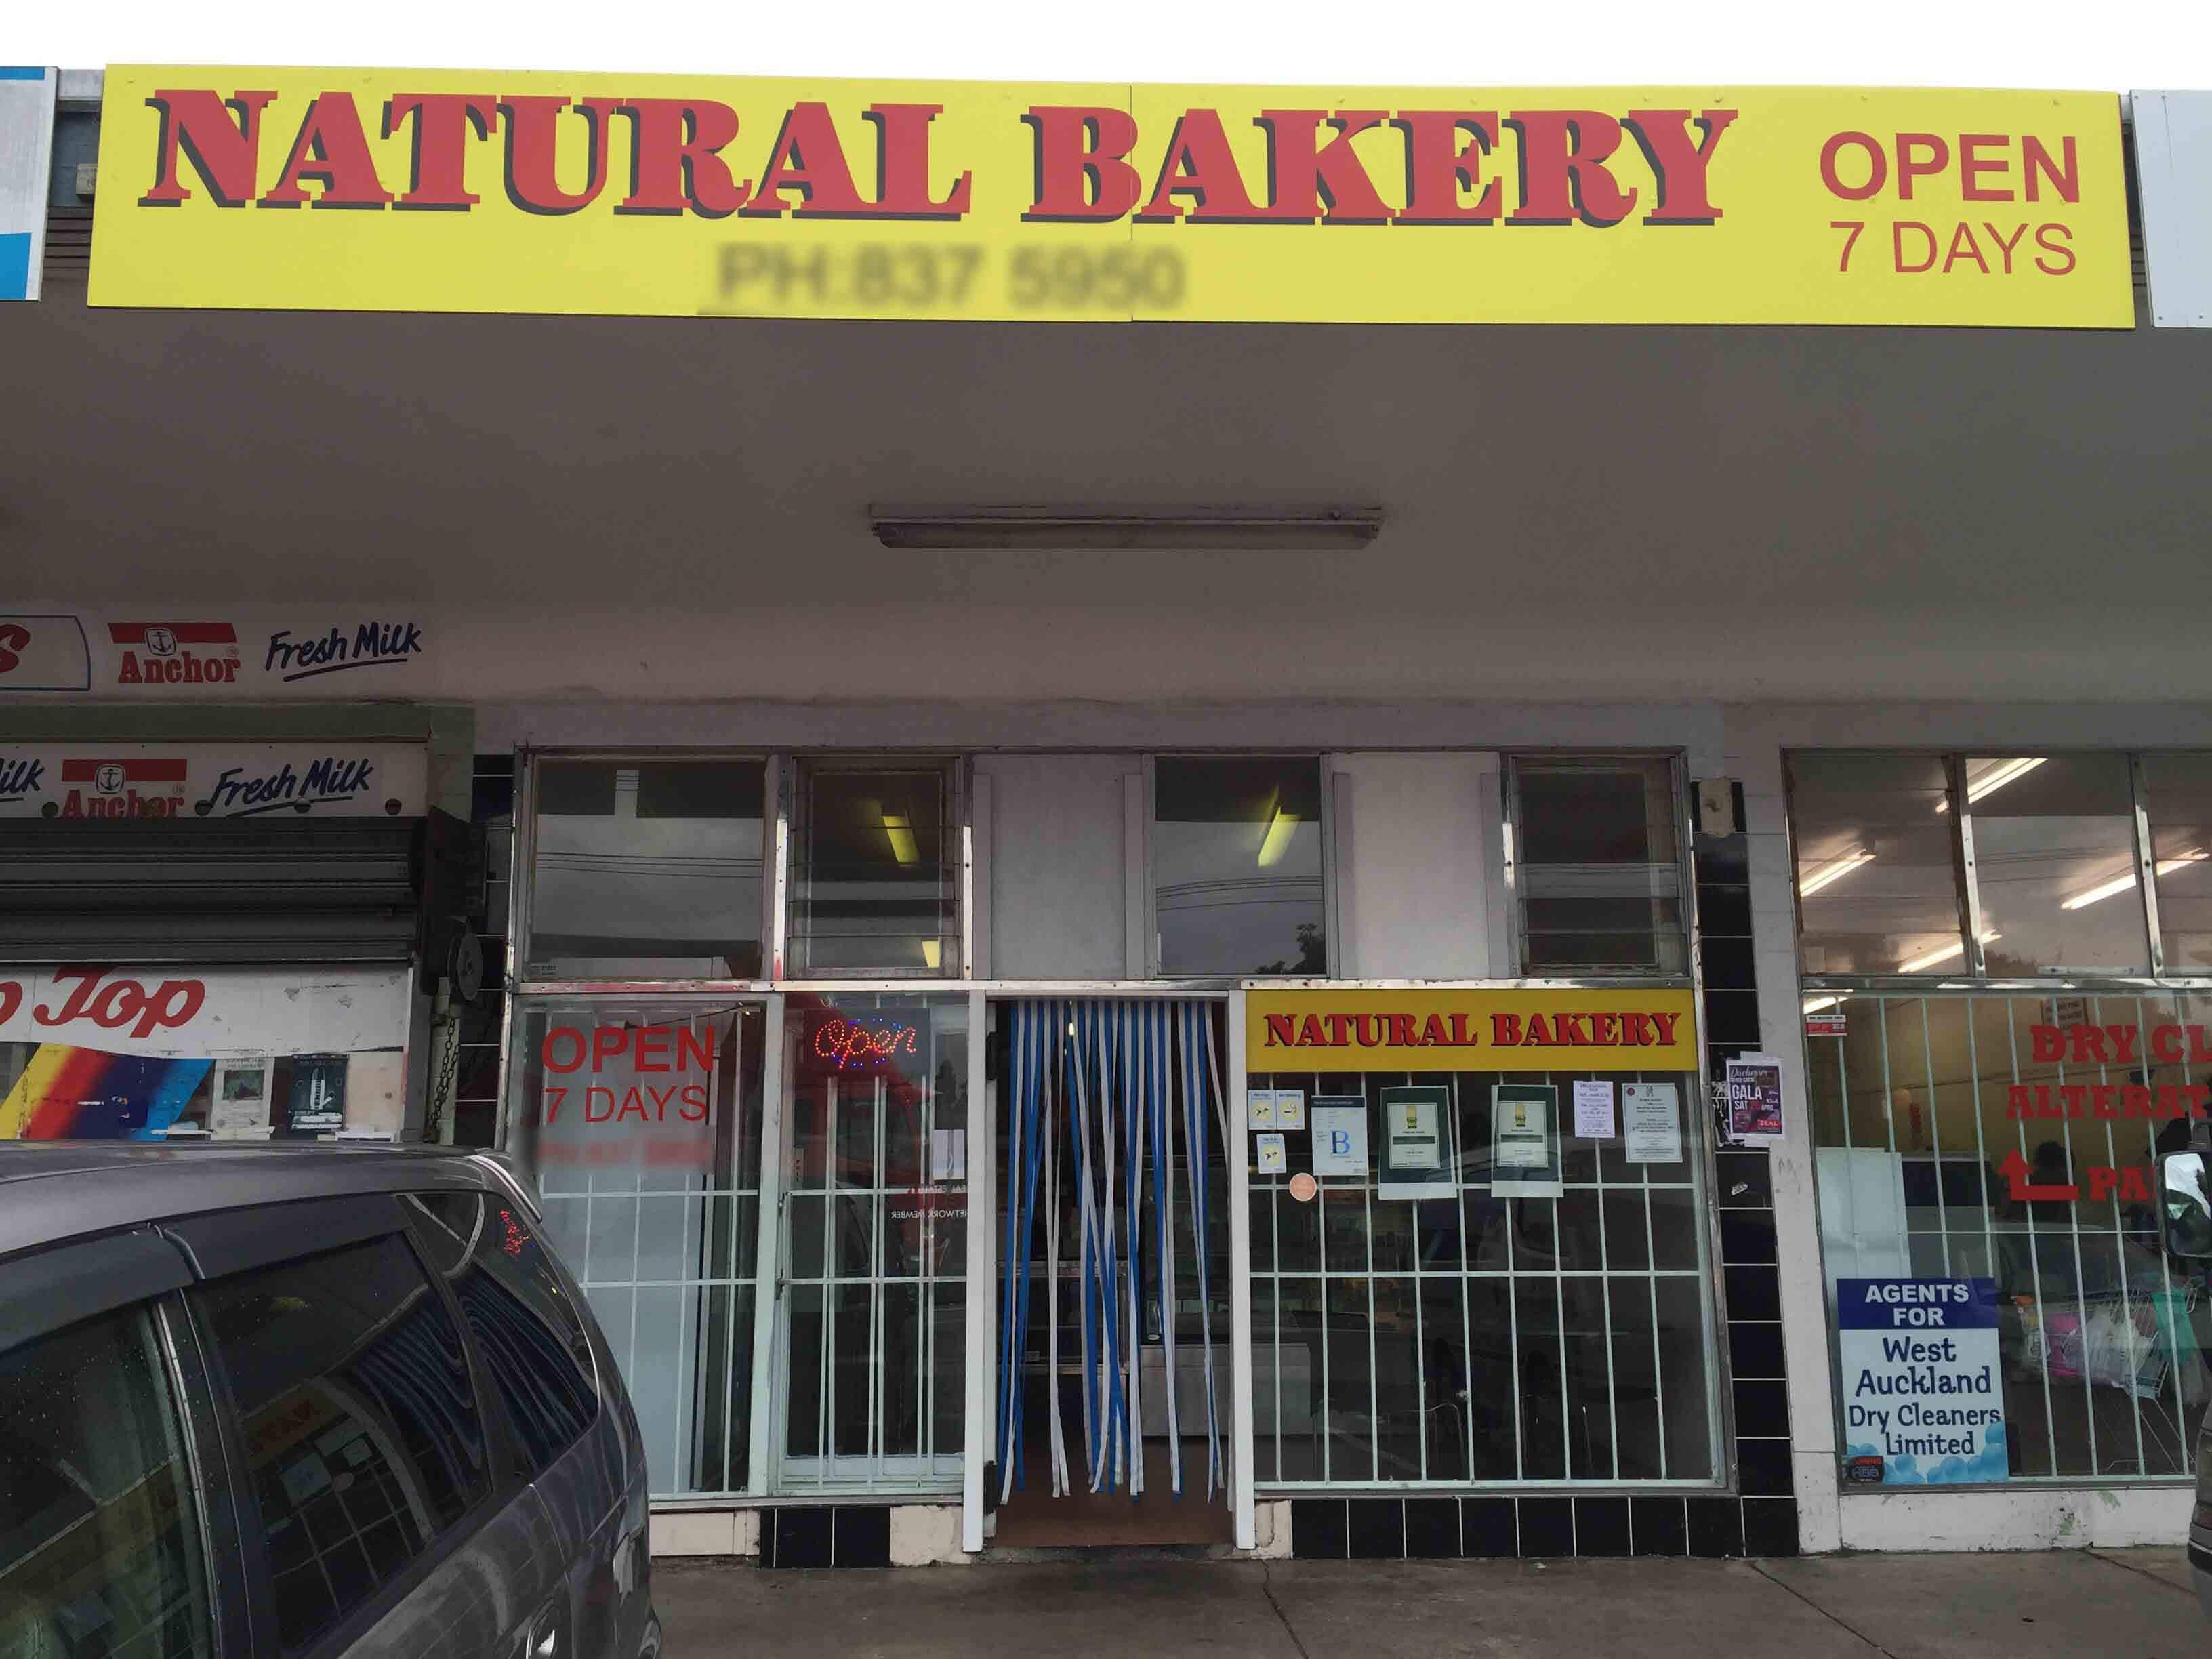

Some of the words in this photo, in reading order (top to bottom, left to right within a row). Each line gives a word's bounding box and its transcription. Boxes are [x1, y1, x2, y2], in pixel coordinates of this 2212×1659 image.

[138, 89, 972, 222] NATURAL
[1021, 105, 1738, 228] BAKERY
[1820, 131, 2080, 203] OPEN
[1830, 221, 1865, 272] 7
[1892, 221, 2077, 276] DAYS
[265, 627, 348, 671] Fresh
[352, 622, 423, 659] Milk
[118, 650, 241, 684] Anchor
[0, 758, 45, 794] ilk
[209, 764, 297, 808] Fresh
[298, 757, 373, 796] Milk
[60, 788, 186, 819] Anchor
[33, 965, 206, 1038] Top
[815, 1018, 918, 1069] Open
[1263, 1013, 1478, 1047] NATURAL
[1490, 1012, 1681, 1047] BAKERY
[2029, 1024, 2137, 1063] DRY
[541, 1025, 716, 1073] OPEN
[544, 1086, 569, 1123] 7
[584, 1084, 707, 1122] DAYS
[1732, 1084, 1763, 1099] GALA
[1734, 1100, 1749, 1111] SAT
[2005, 1085, 2211, 1118] ALTERAT
[1330, 1130, 1351, 1155] B
[2086, 1166, 2156, 1203] PA
[1865, 1284, 1970, 1303] AGENTS
[1893, 1307, 1946, 1326] FOR
[1882, 1336, 1957, 1364] West
[1855, 1365, 1992, 1397] Auckland
[1849, 1404, 1890, 1435] Dry
[1897, 1401, 2001, 1427] Cleaners
[1885, 1431, 1975, 1456] Limited
